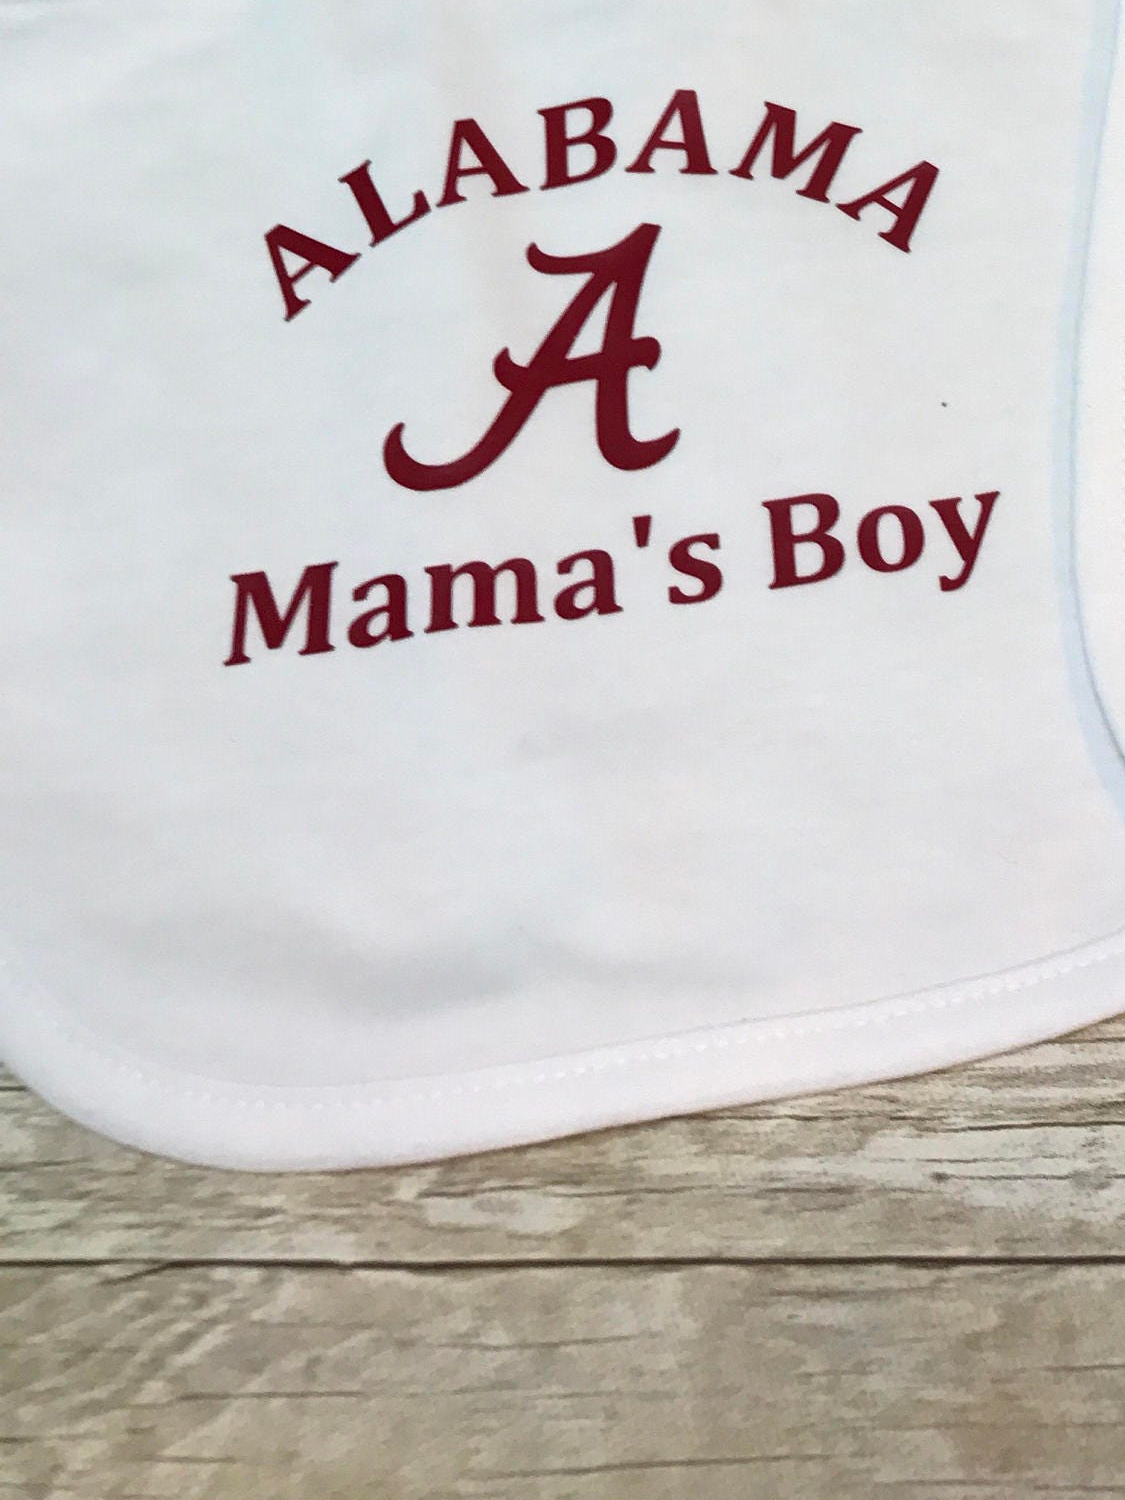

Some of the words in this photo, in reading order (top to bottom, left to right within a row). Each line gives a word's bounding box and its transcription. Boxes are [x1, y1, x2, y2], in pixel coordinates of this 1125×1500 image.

[265, 89, 939, 319] ALABAMA
[383, 223, 680, 491] A
[224, 515, 722, 666] Mama's
[762, 491, 999, 592] Boy
